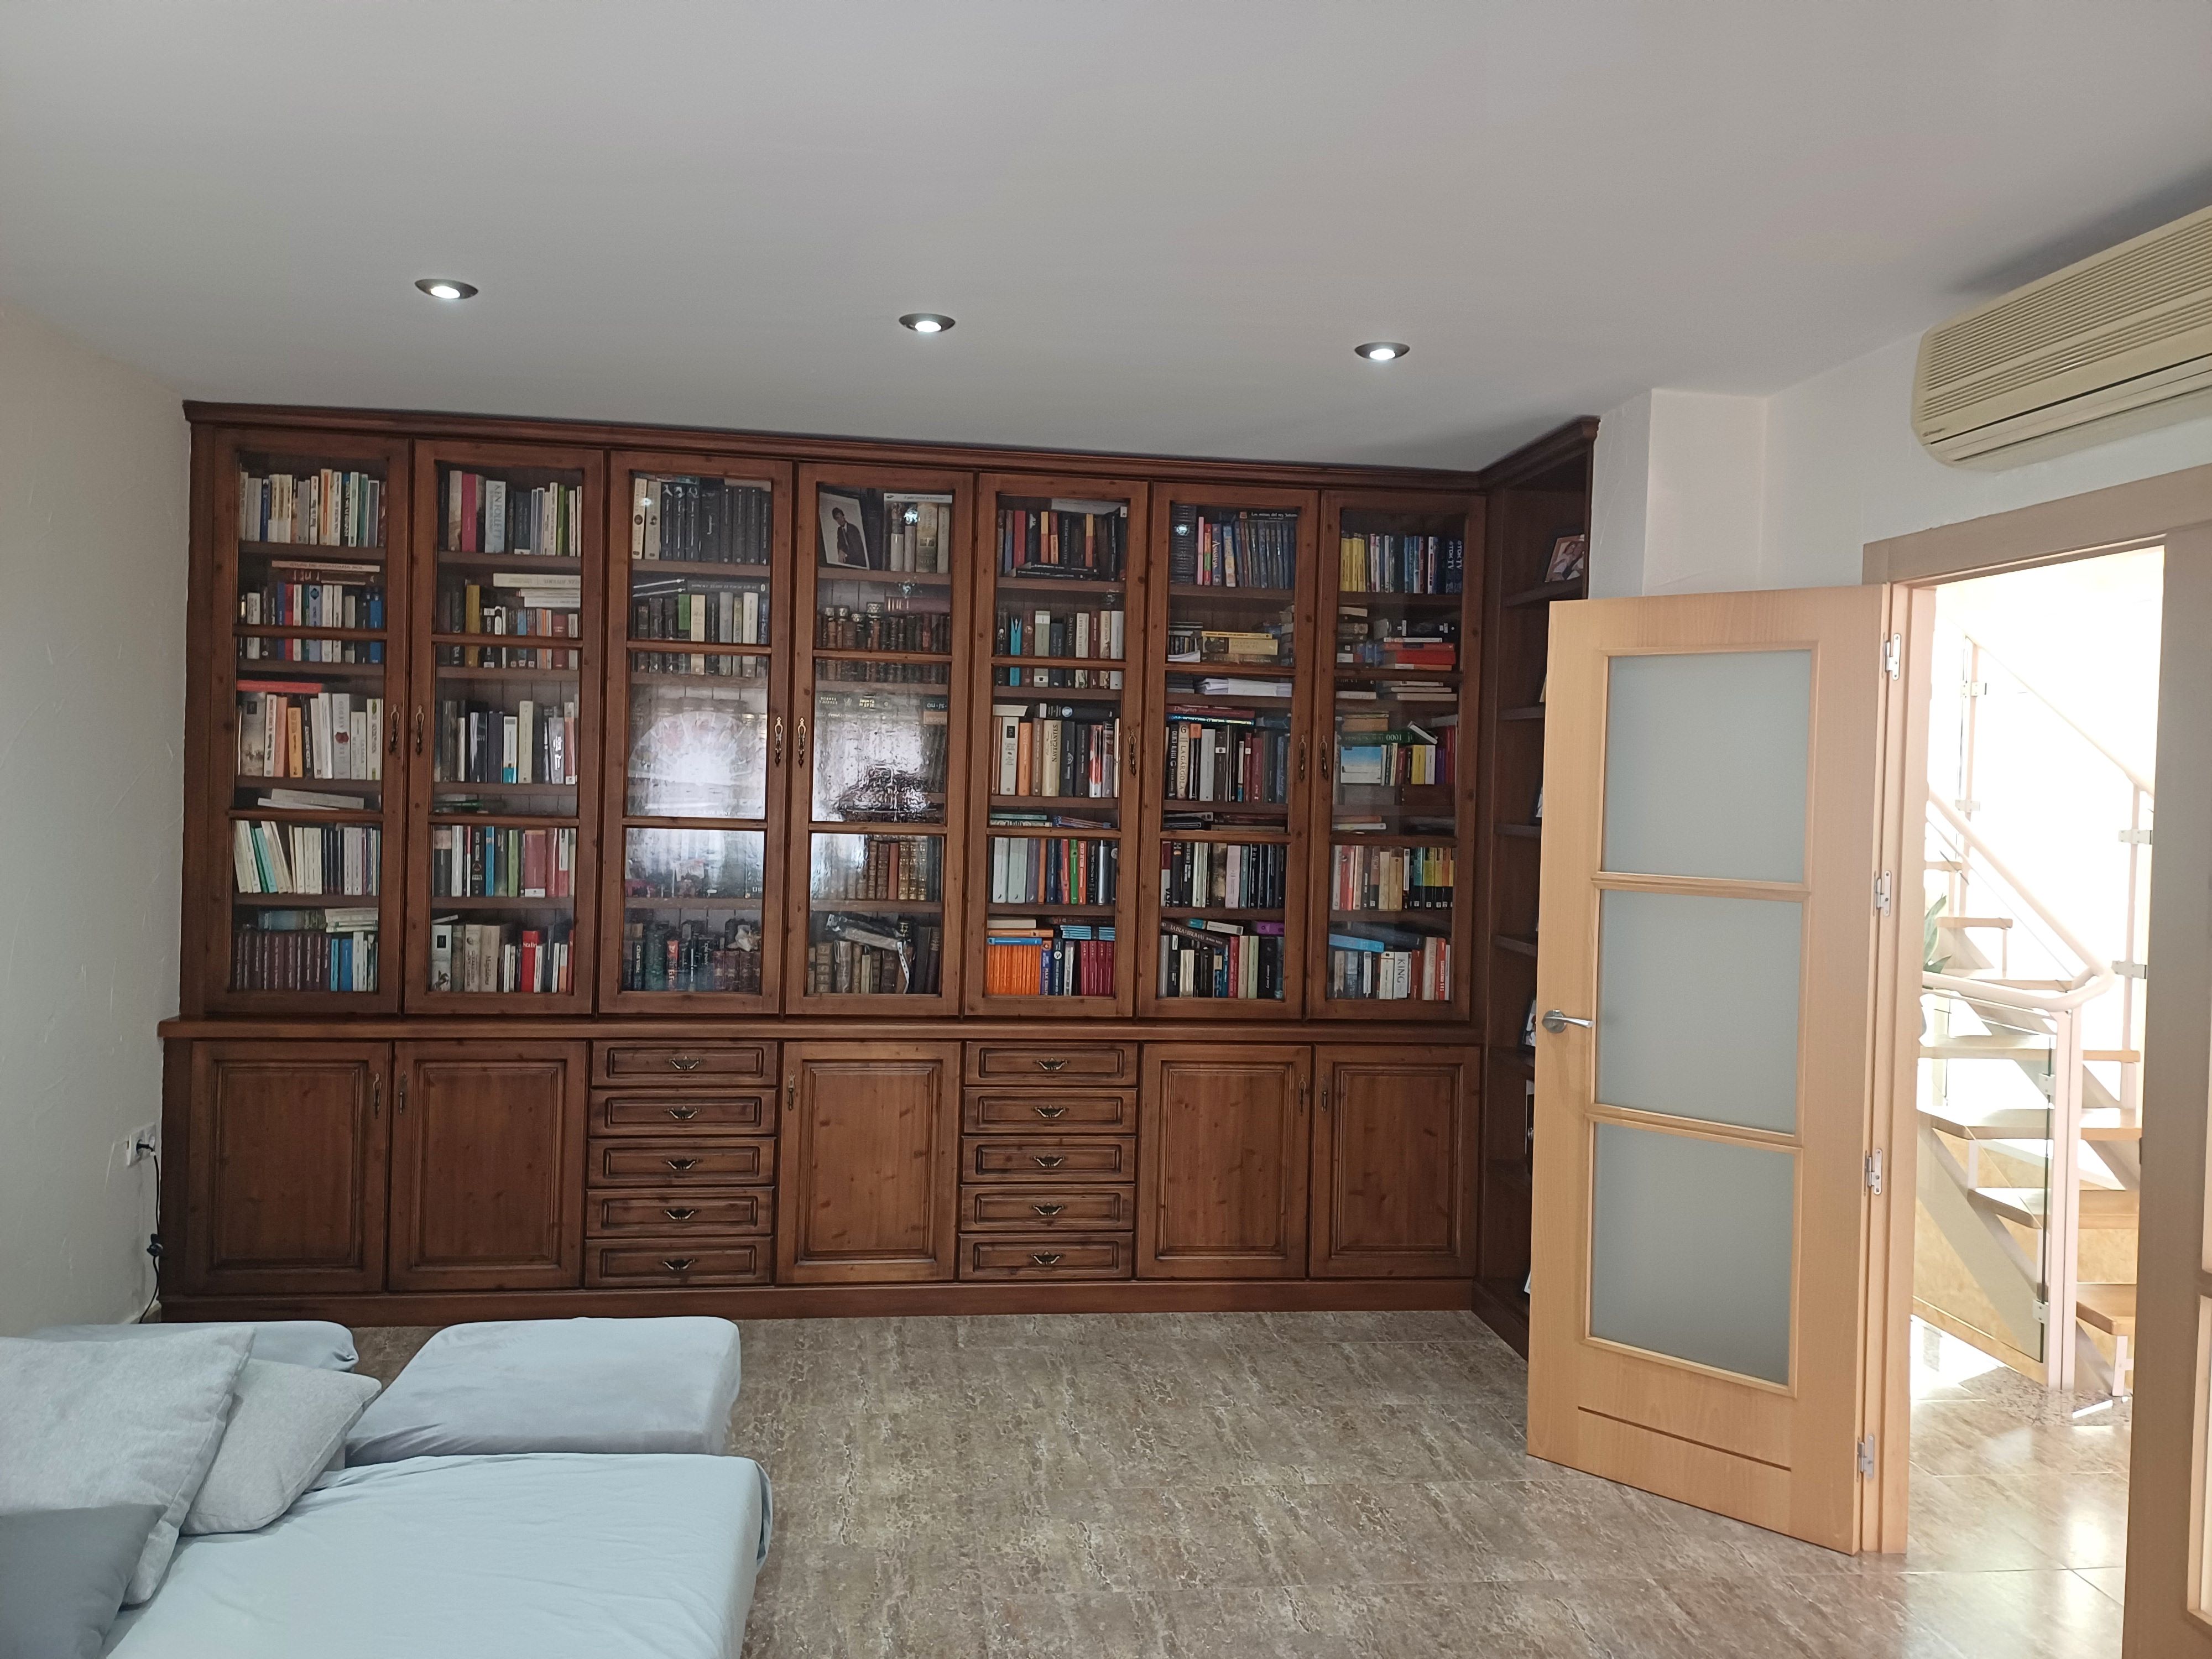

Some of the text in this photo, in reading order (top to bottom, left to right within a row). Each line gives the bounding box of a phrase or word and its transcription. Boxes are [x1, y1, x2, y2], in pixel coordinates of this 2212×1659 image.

[493, 504, 502, 540] FOLLETT
[1447, 560, 1454, 570] TV
[1456, 559, 1462, 570] TV
[1181, 745, 1186, 754] LA
[1397, 959, 1405, 983] KING
